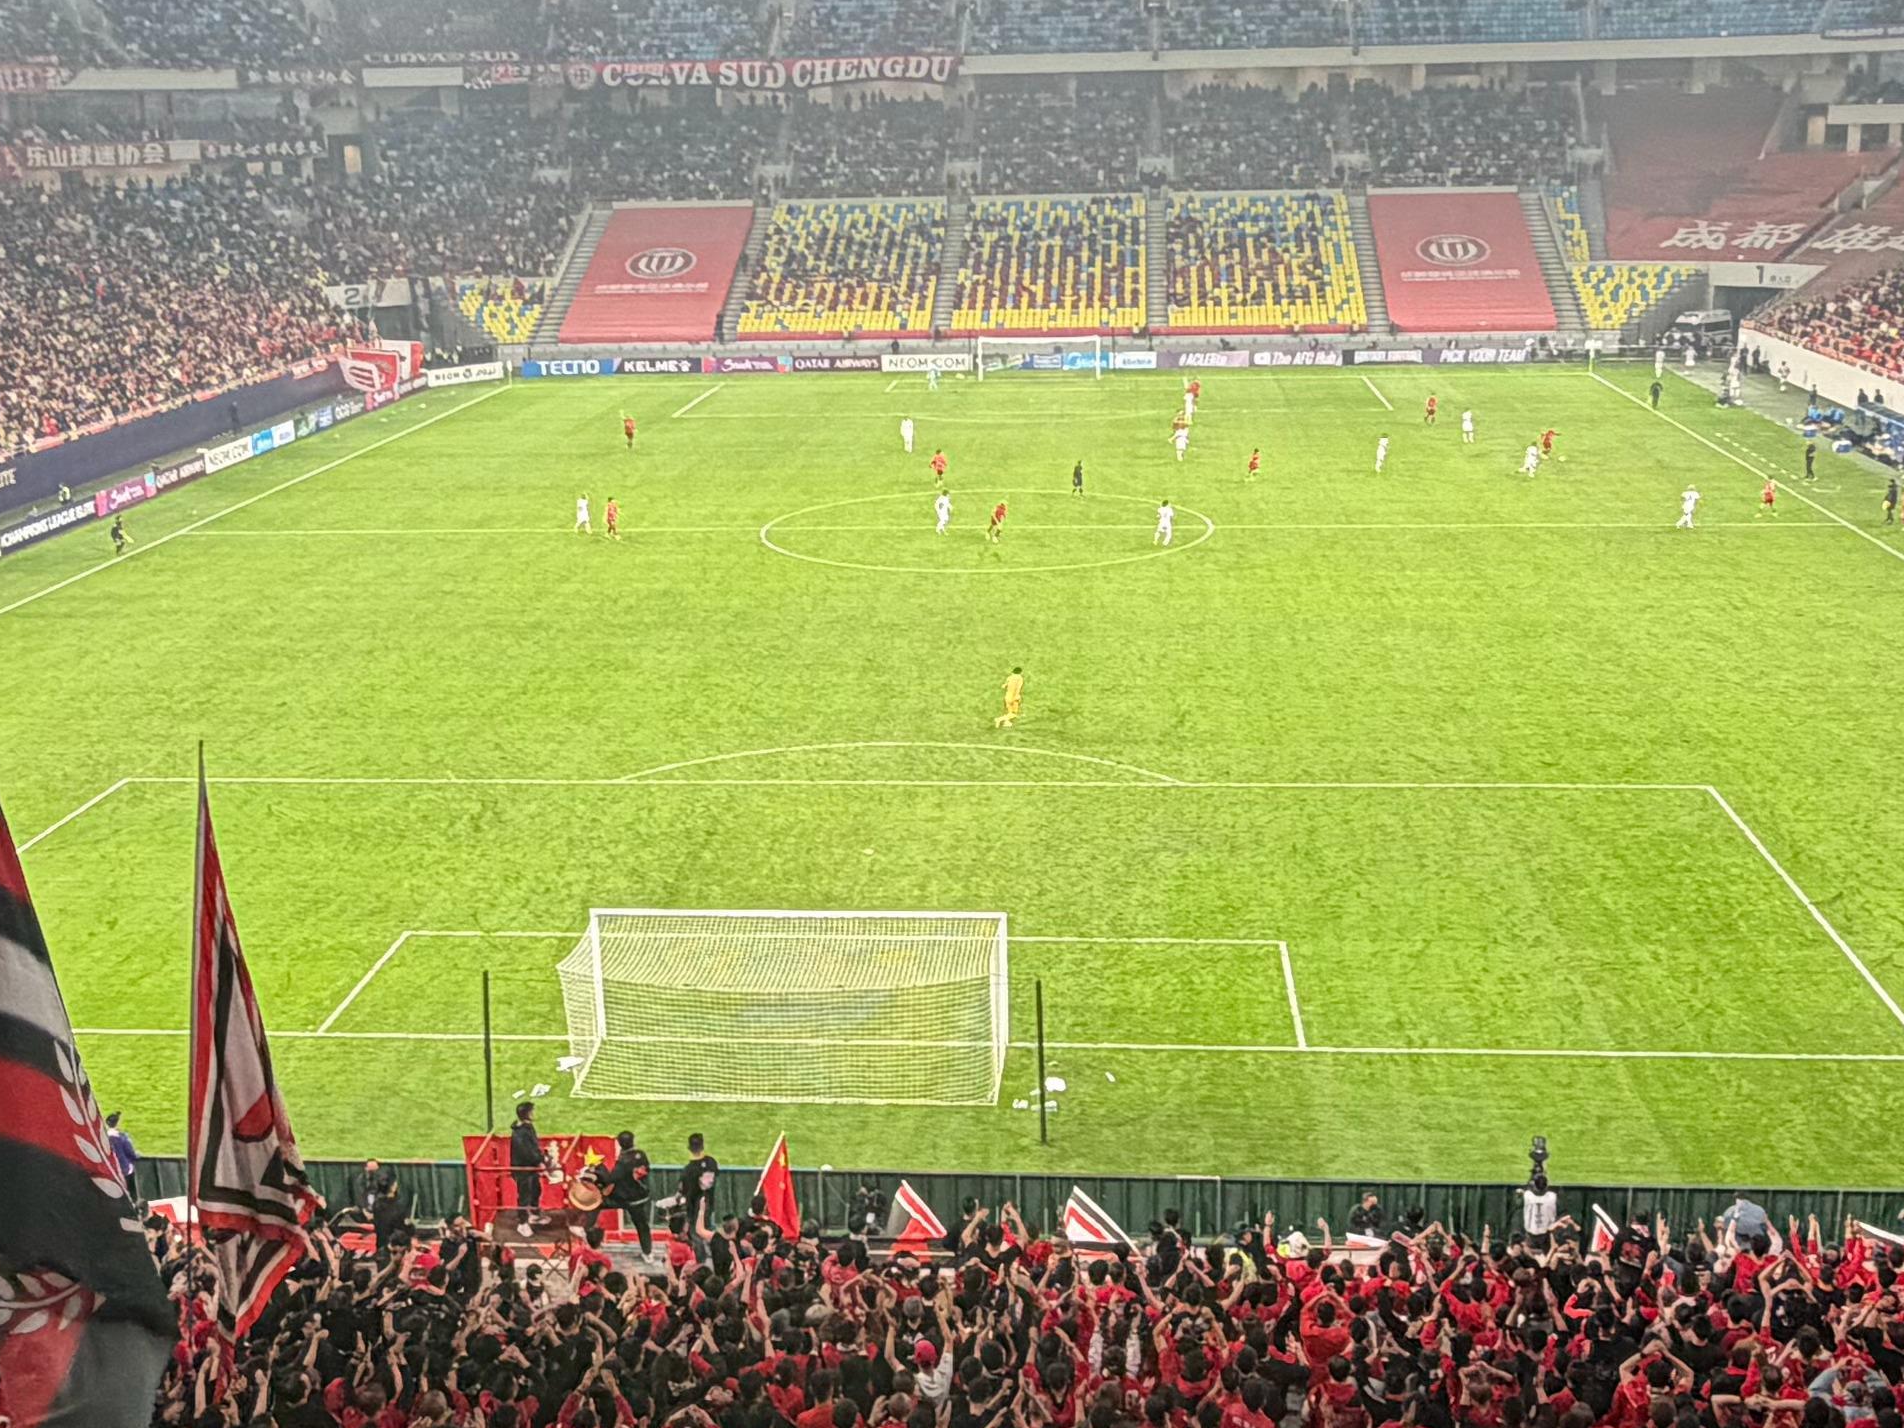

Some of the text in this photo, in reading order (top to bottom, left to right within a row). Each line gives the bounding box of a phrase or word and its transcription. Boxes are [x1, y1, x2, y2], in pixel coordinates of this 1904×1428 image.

[719, 62, 786, 89] SUD
[792, 56, 955, 88] CHENGDU
[537, 359, 600, 375] TECNO
[624, 360, 679, 373] KELME
[889, 357, 965, 369] NEOMCOM
